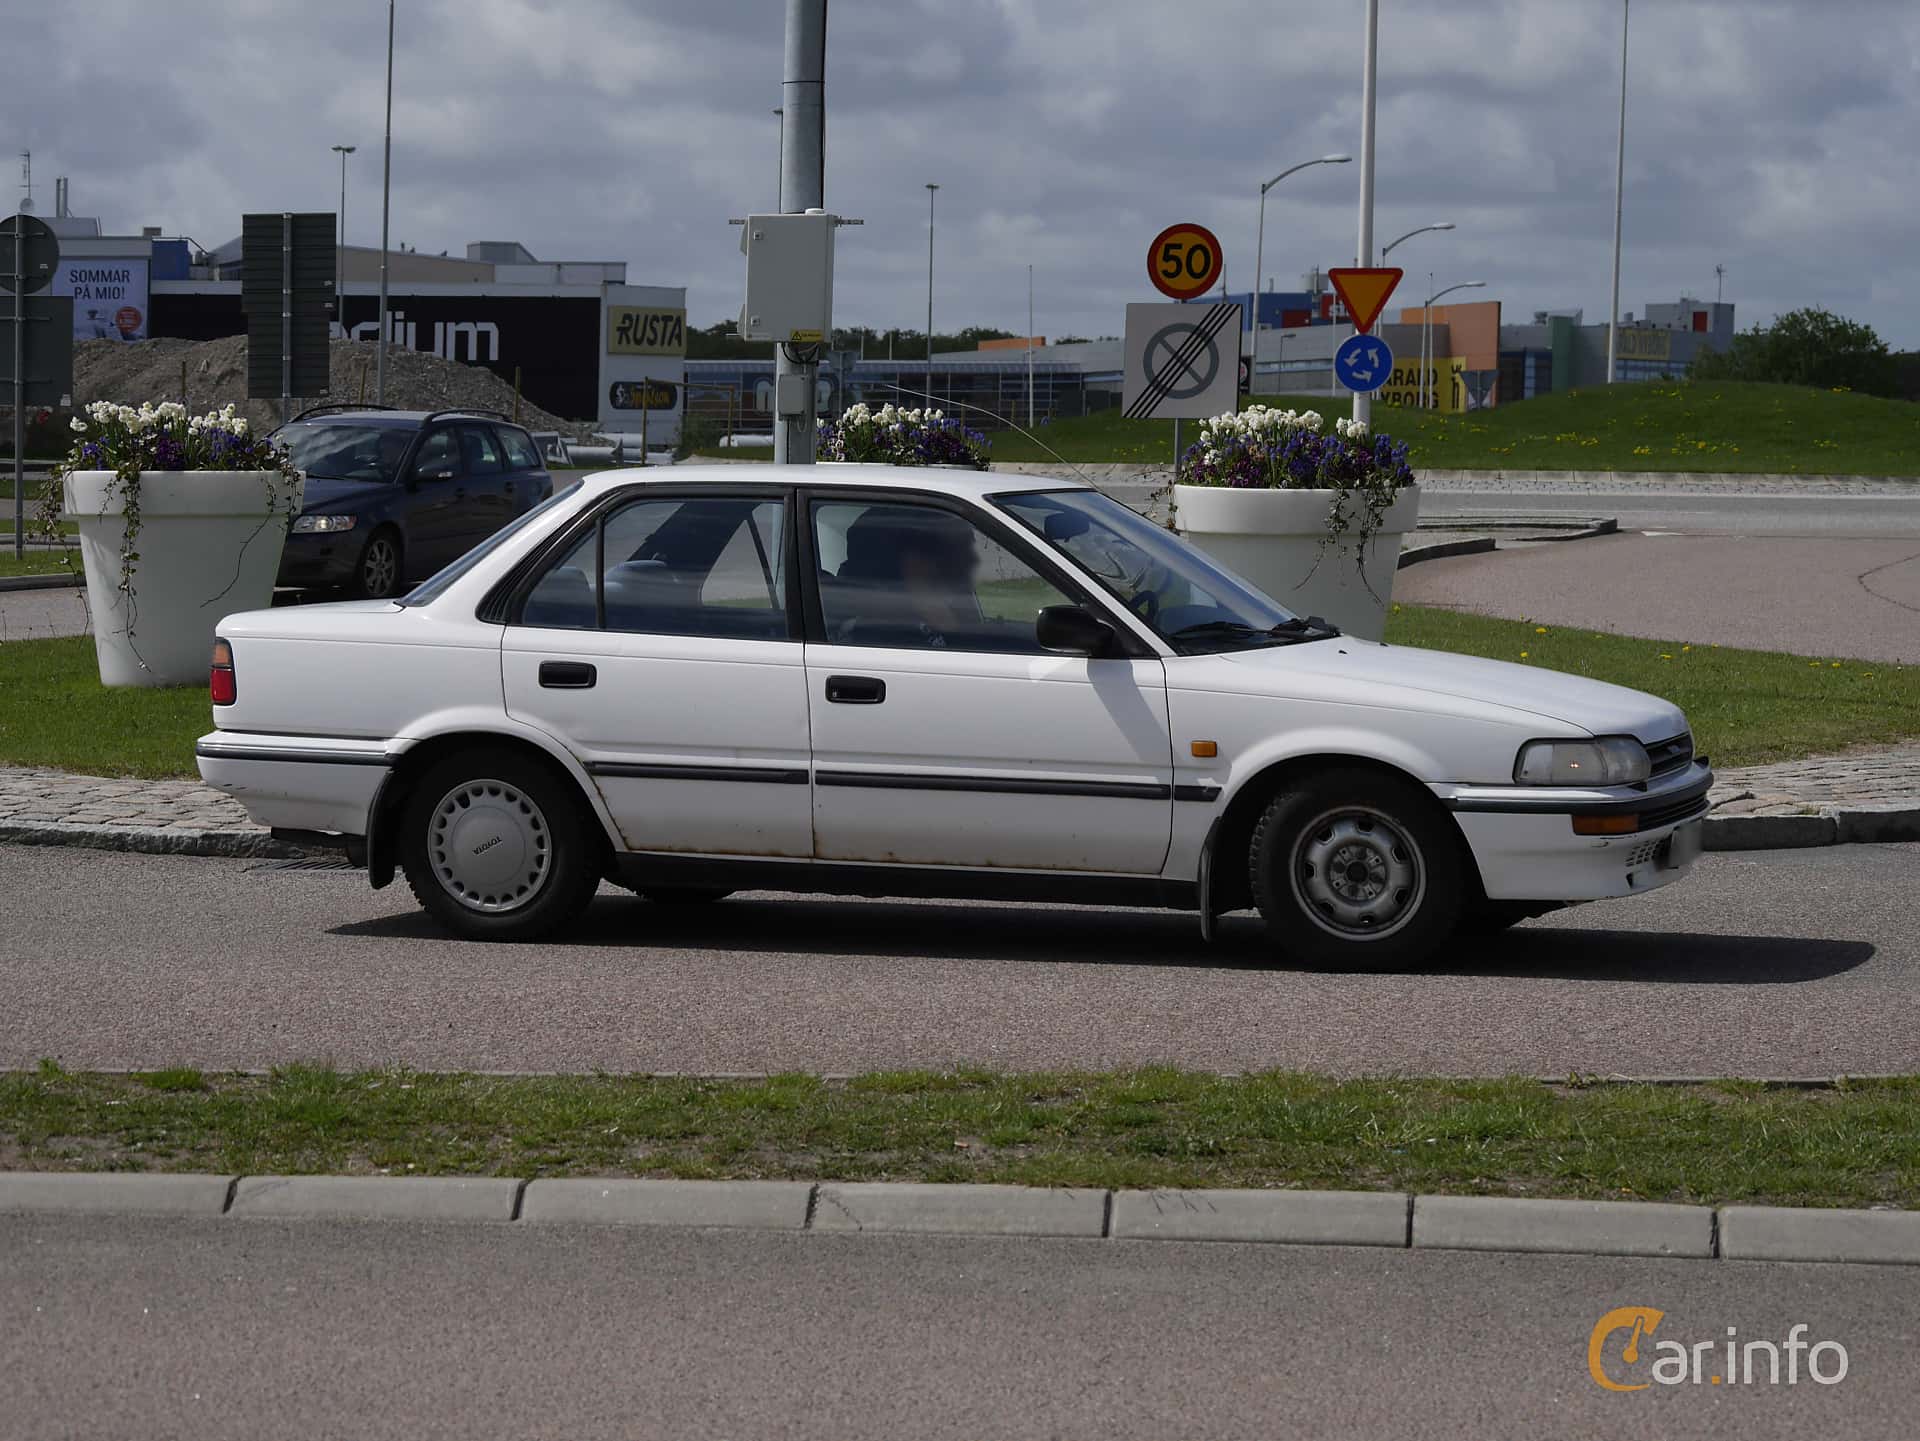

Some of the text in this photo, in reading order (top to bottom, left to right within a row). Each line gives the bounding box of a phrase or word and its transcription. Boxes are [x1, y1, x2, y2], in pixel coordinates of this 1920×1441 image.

[1161, 243, 1211, 279] 50
[69, 269, 130, 283] SOMMAR
[74, 284, 125, 300] PÅ MIO!
[329, 310, 500, 361] dium
[616, 312, 682, 347] RUSTA
[473, 836, 502, 855] TOYOTA
